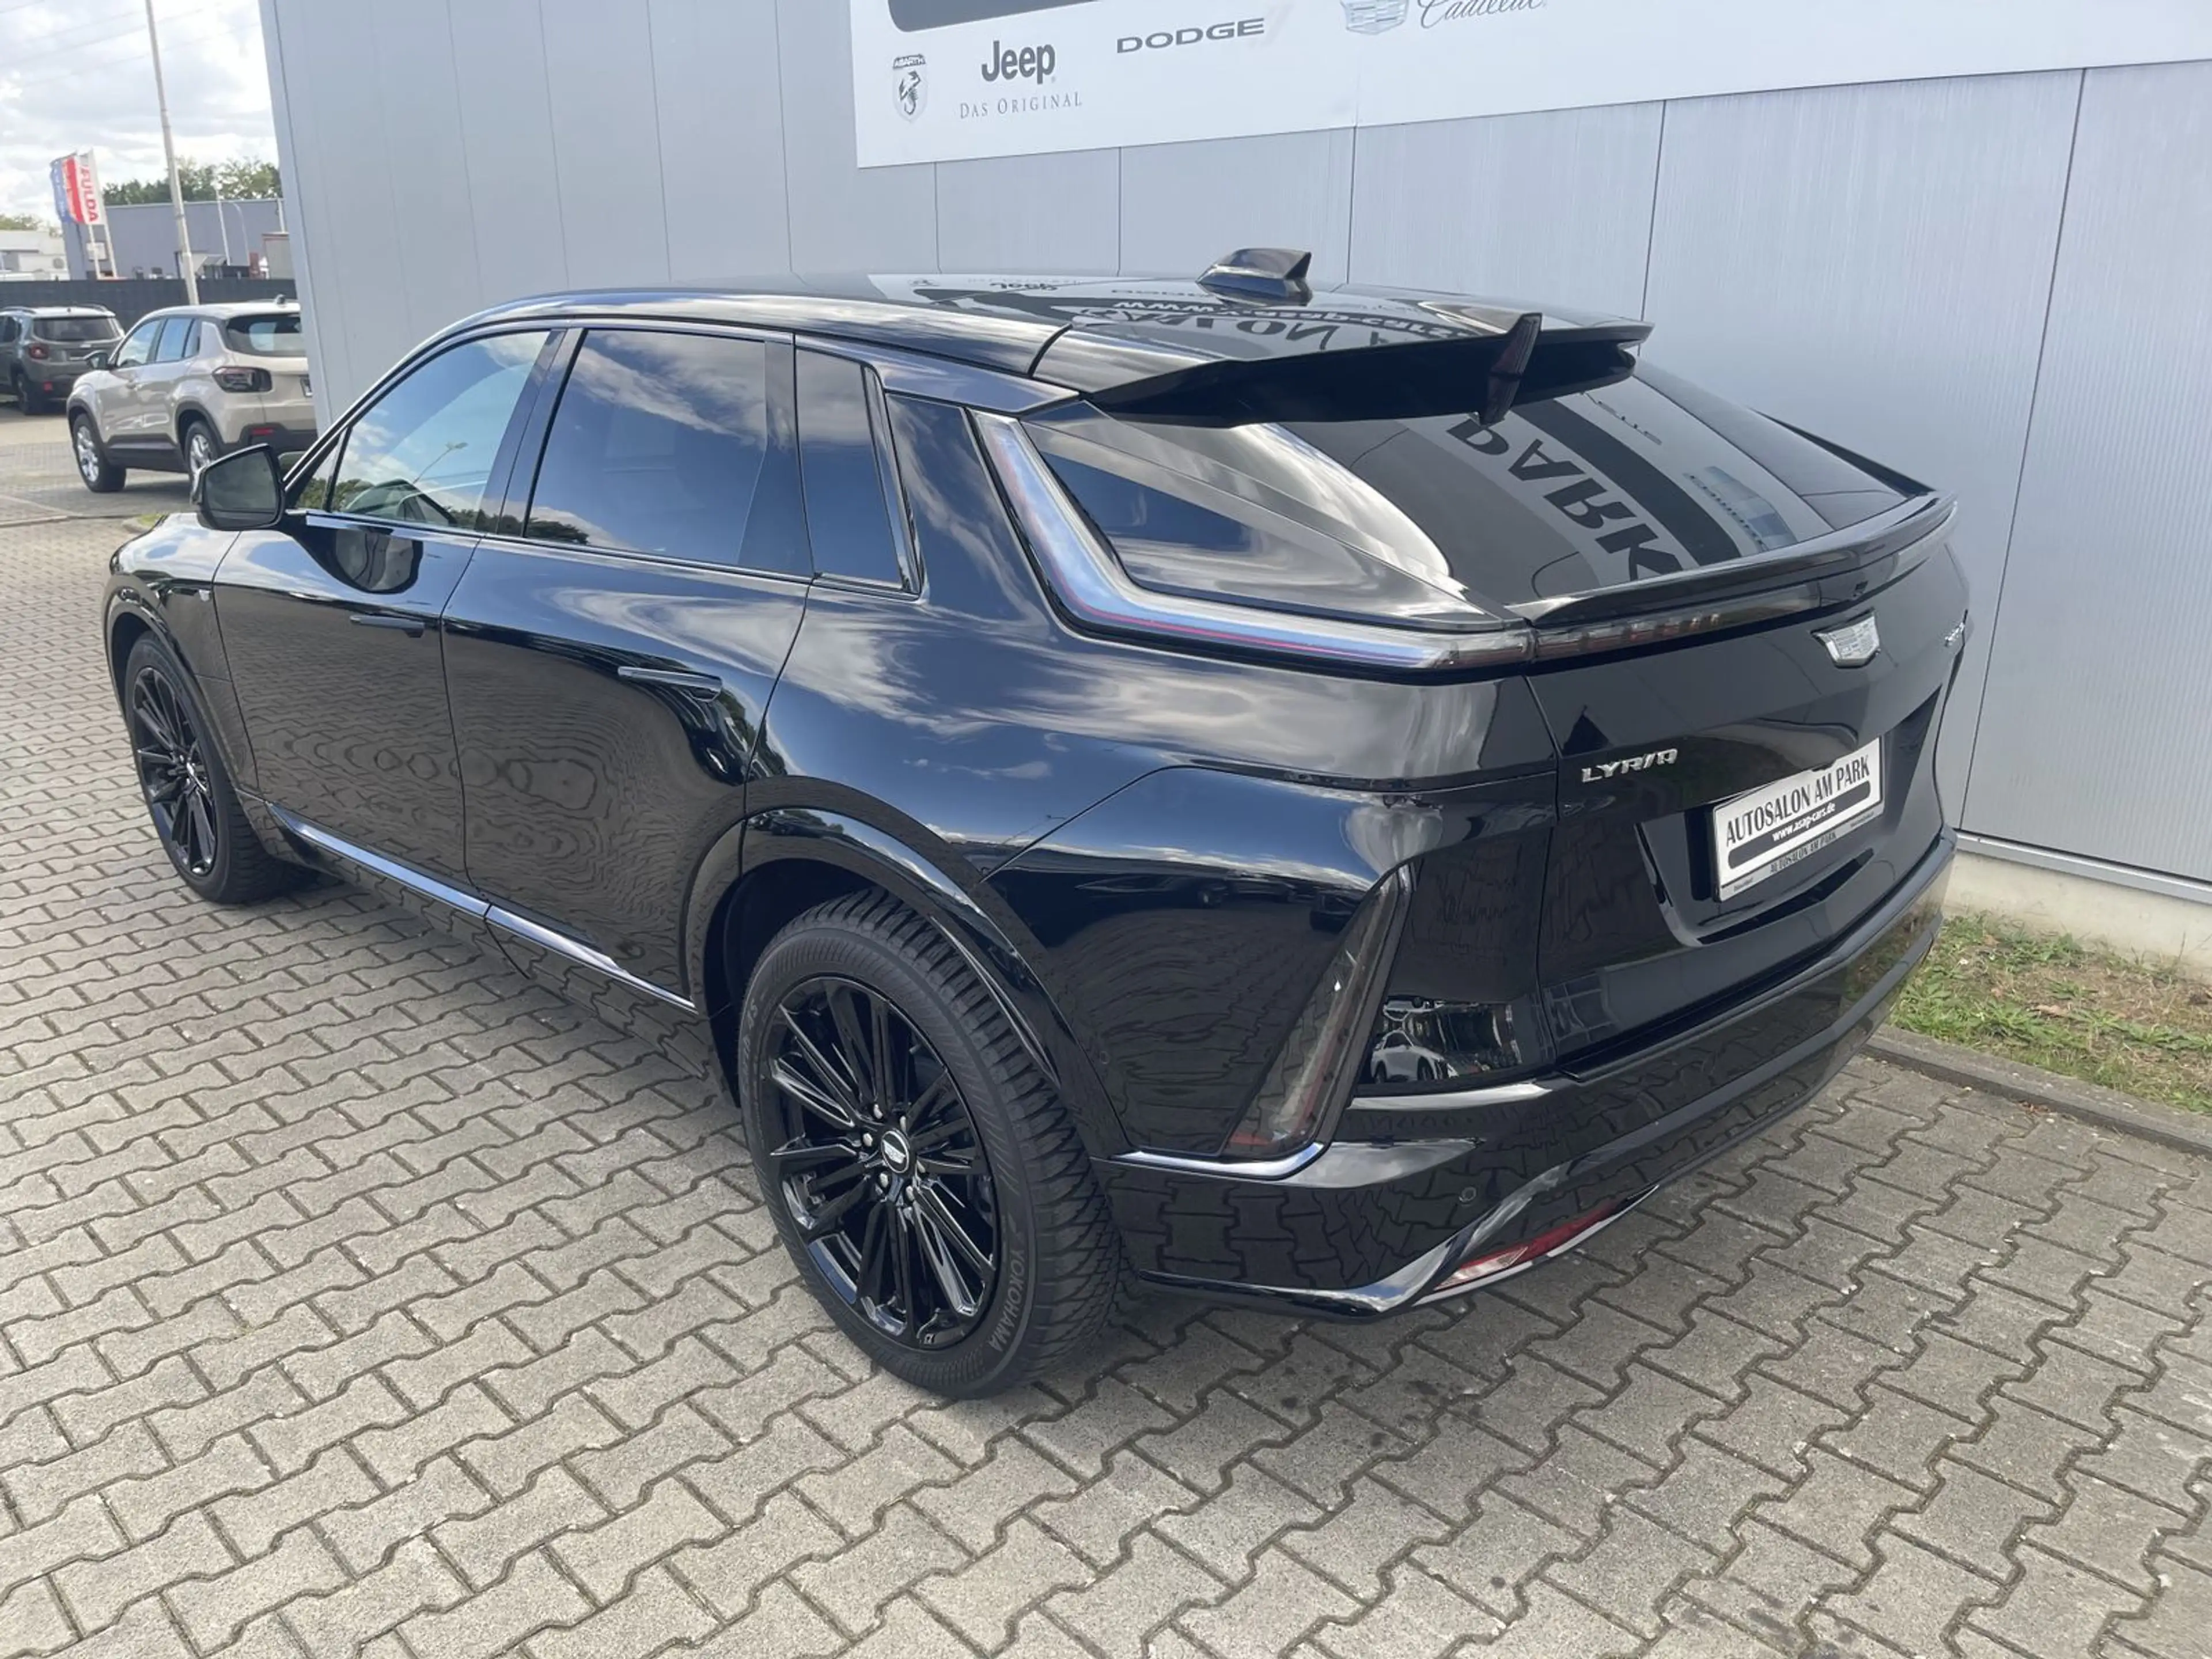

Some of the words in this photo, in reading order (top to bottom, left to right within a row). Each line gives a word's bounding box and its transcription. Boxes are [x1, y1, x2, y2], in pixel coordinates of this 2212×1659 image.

[1116, 18, 1264, 53] DODGE
[981, 40, 1056, 85] Jeep
[960, 102, 988, 119] DAS
[997, 91, 1082, 115] ORIGINAL
[1726, 784, 1811, 847] AUTOSALON
[1815, 772, 1834, 803] AM
[1836, 754, 1870, 791] PARK
[987, 1249, 1025, 1352] YOKOHAMA
